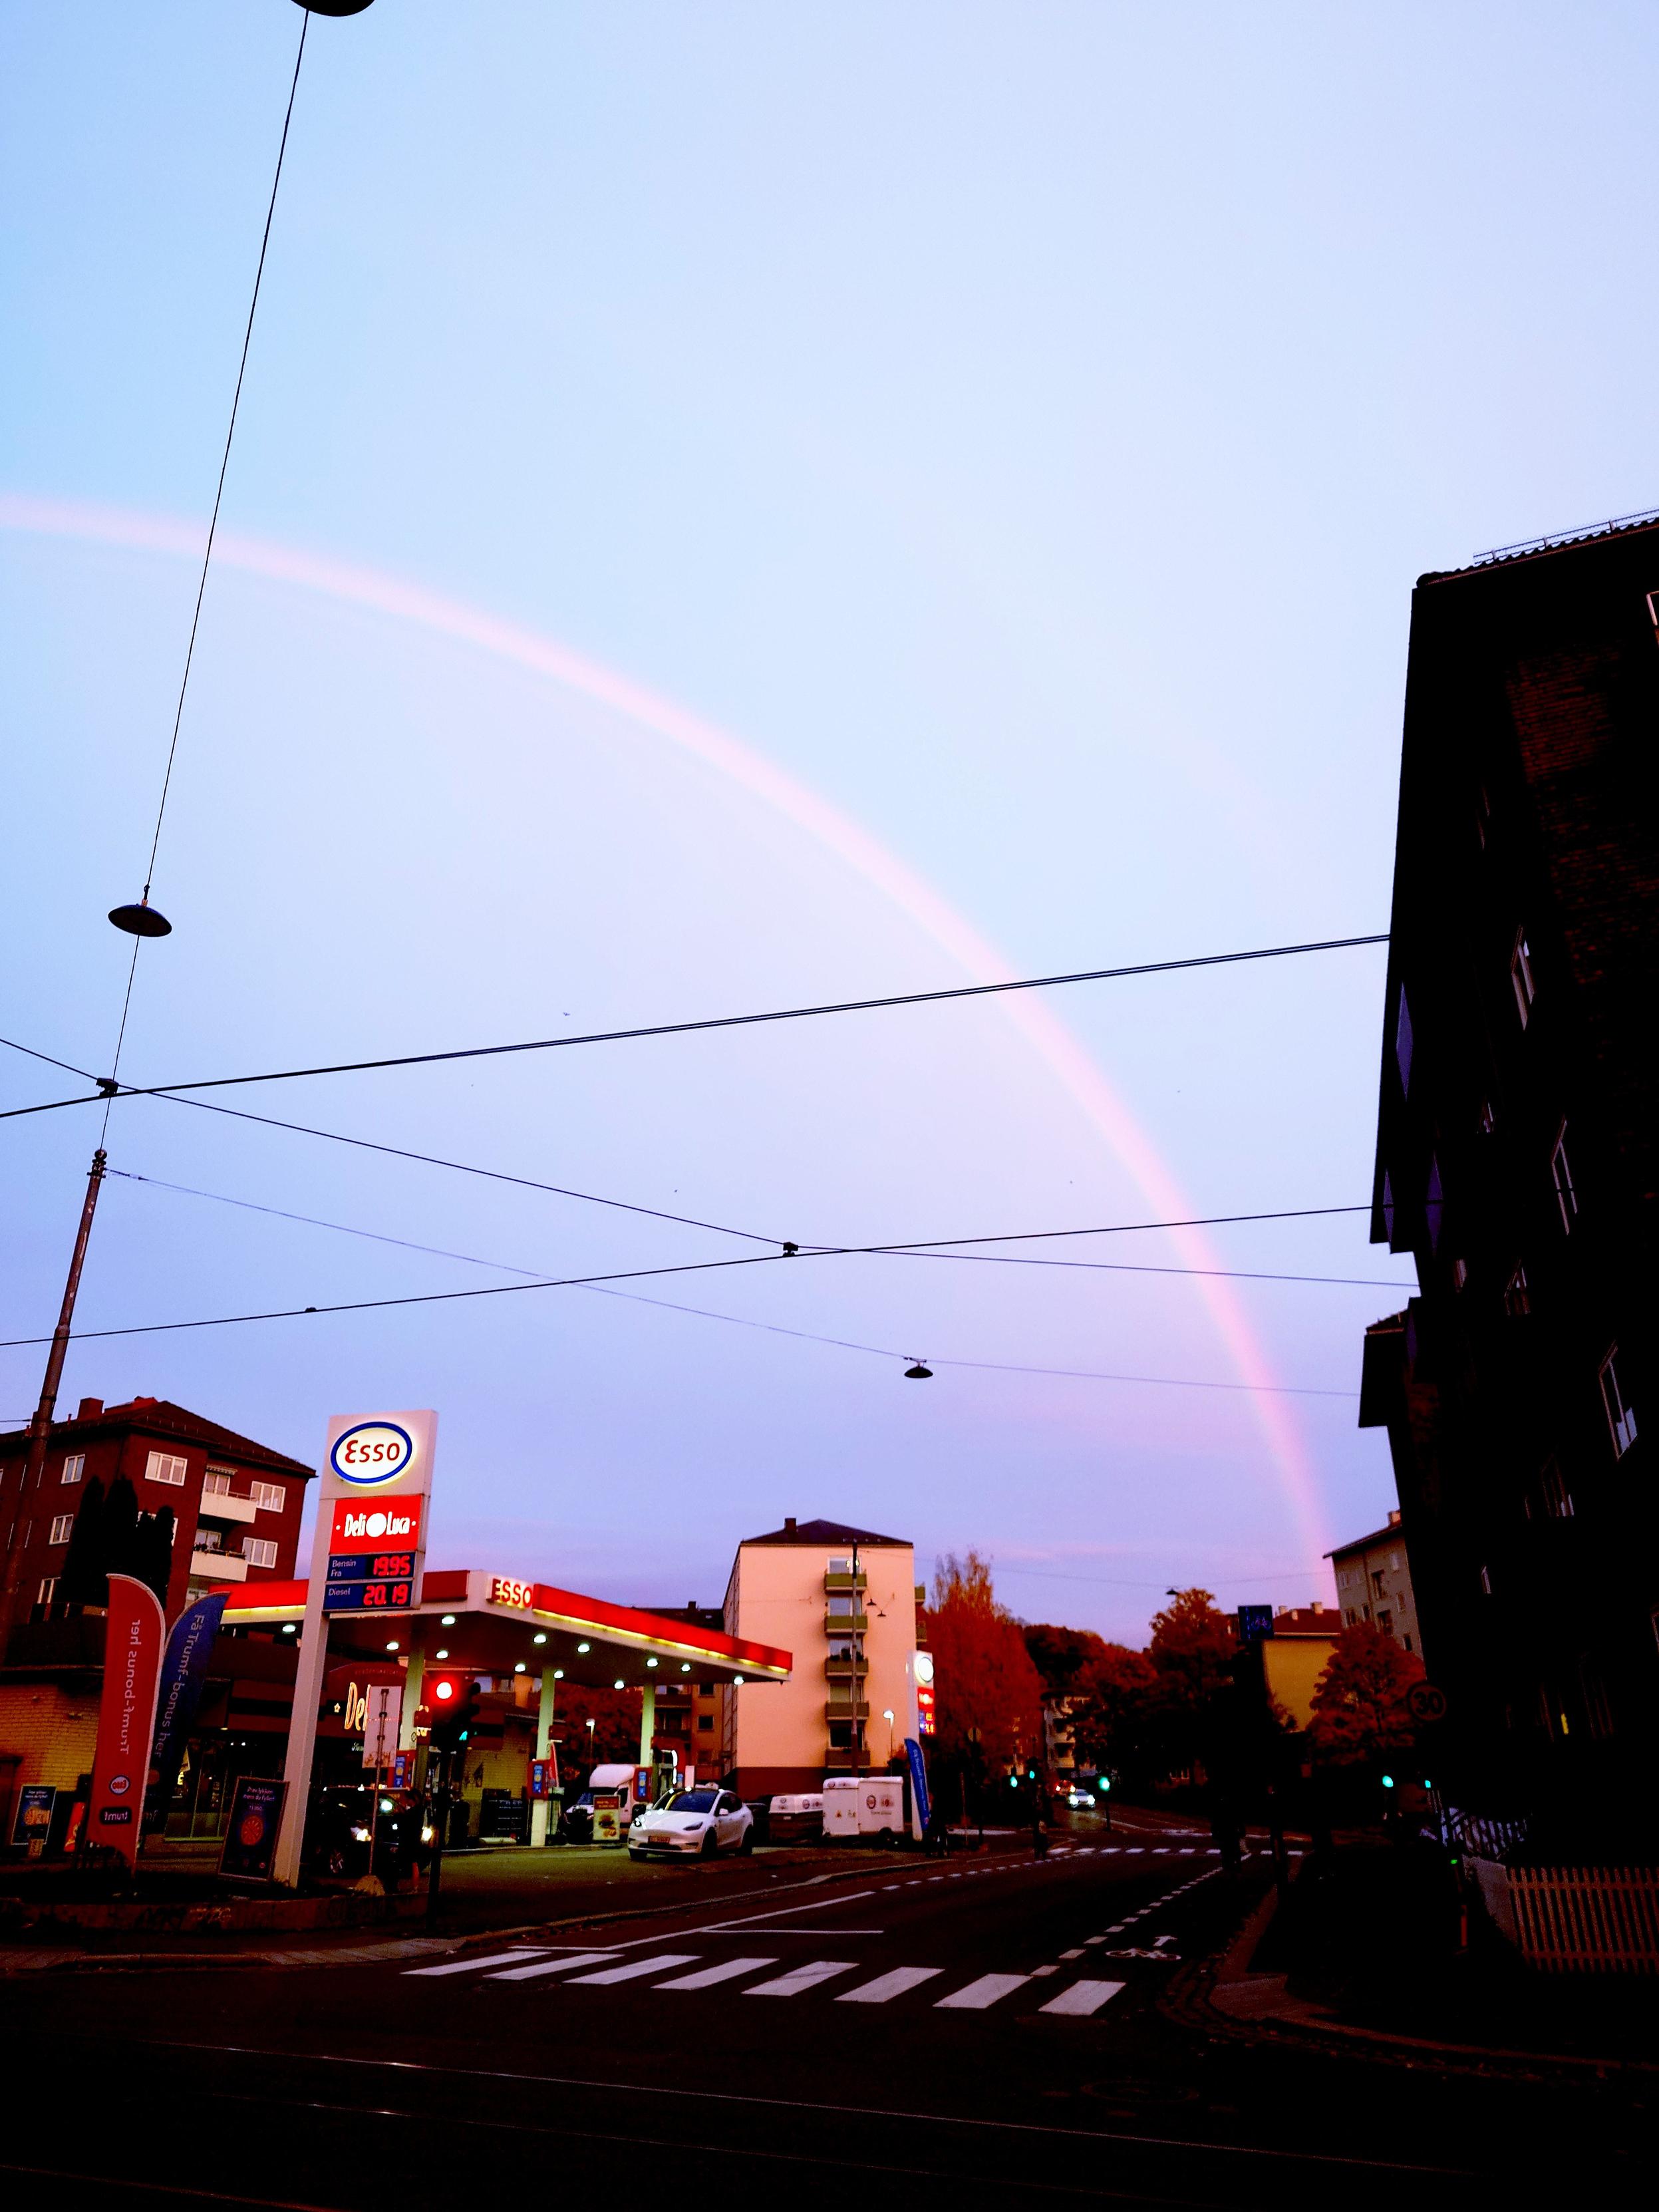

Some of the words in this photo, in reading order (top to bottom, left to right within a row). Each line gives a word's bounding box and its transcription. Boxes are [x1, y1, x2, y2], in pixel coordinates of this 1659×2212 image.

[345, 1440, 400, 1464] Esso
[344, 1513, 366, 1537] Deli
[386, 1511, 410, 1535] Luca
[332, 1559, 357, 1568] Bensin
[373, 1555, 410, 1577] 19.95
[328, 1587, 351, 1596] Diesel
[363, 1584, 408, 1606] 20.19
[1414, 1692, 1442, 1714] 30
[154, 1732, 171, 1758] her
